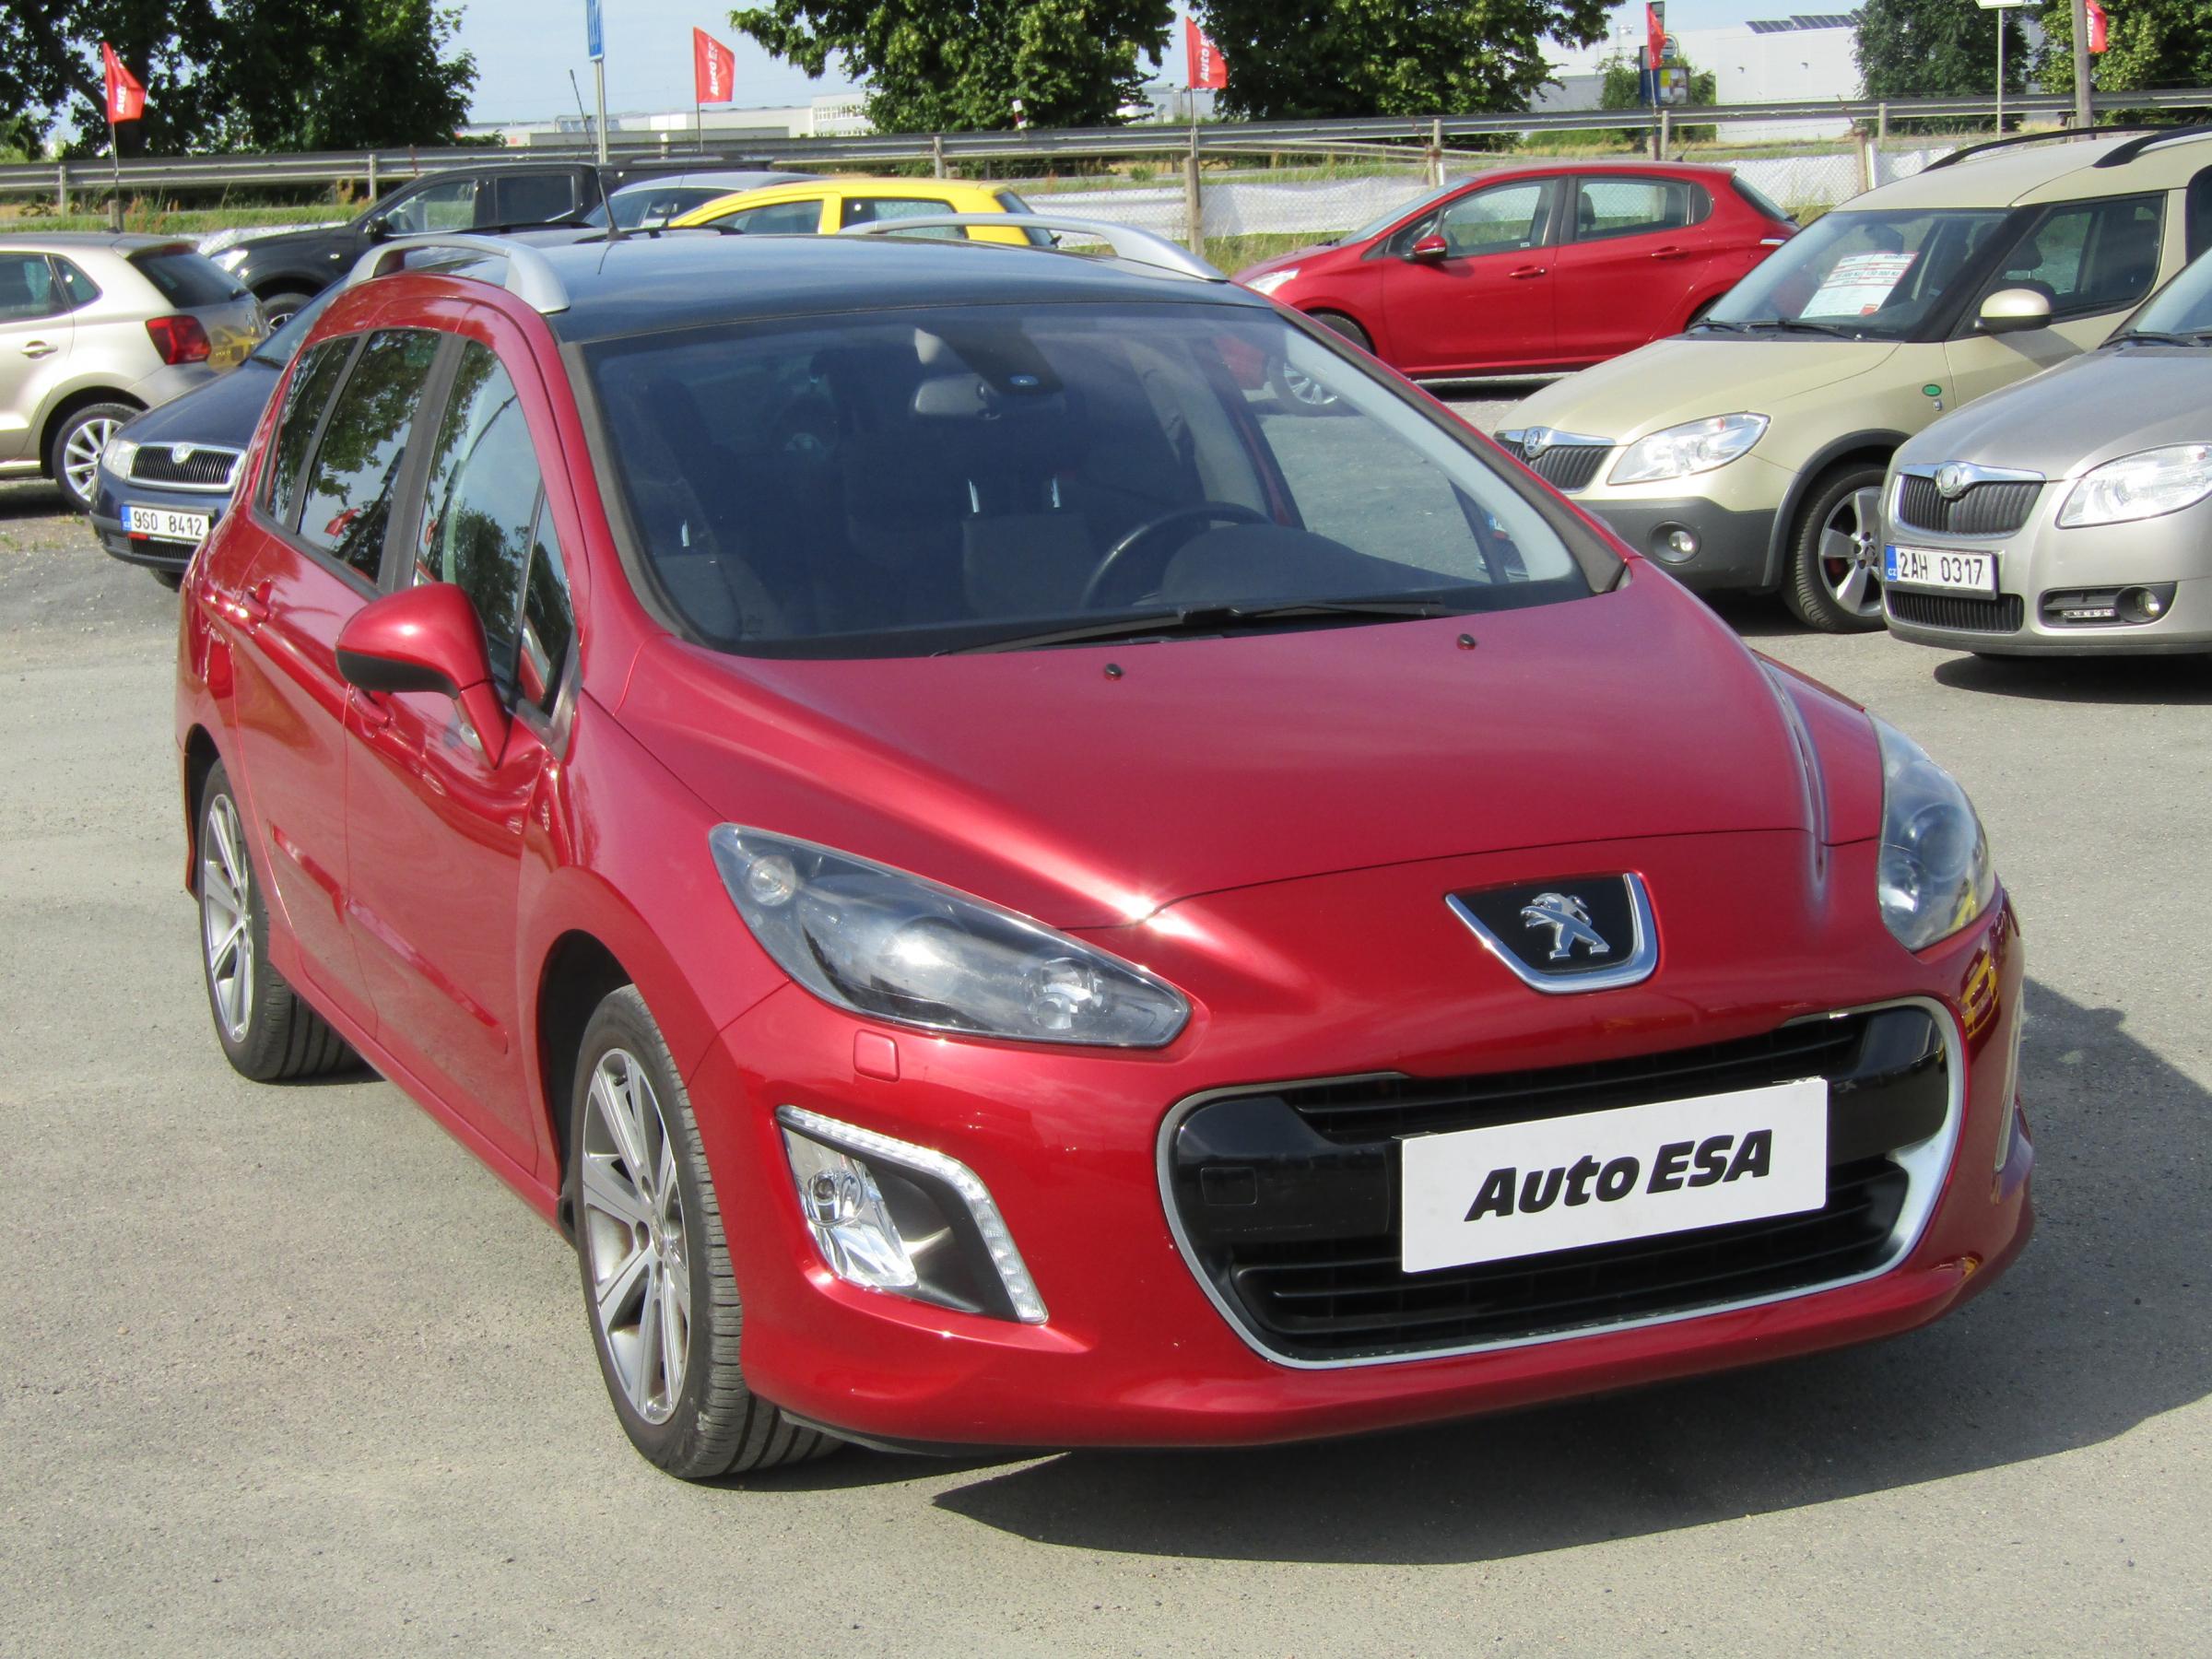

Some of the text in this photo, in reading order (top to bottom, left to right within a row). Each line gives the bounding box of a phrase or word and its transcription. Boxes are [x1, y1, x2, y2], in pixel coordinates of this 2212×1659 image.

[1200, 48, 1209, 82] Auto
[134, 511, 158, 531] 9S0
[169, 514, 202, 536] 8412
[1900, 552, 1928, 581] 2AH
[1940, 556, 1983, 584] 0317
[1464, 1128, 1772, 1222] Auto ESA
